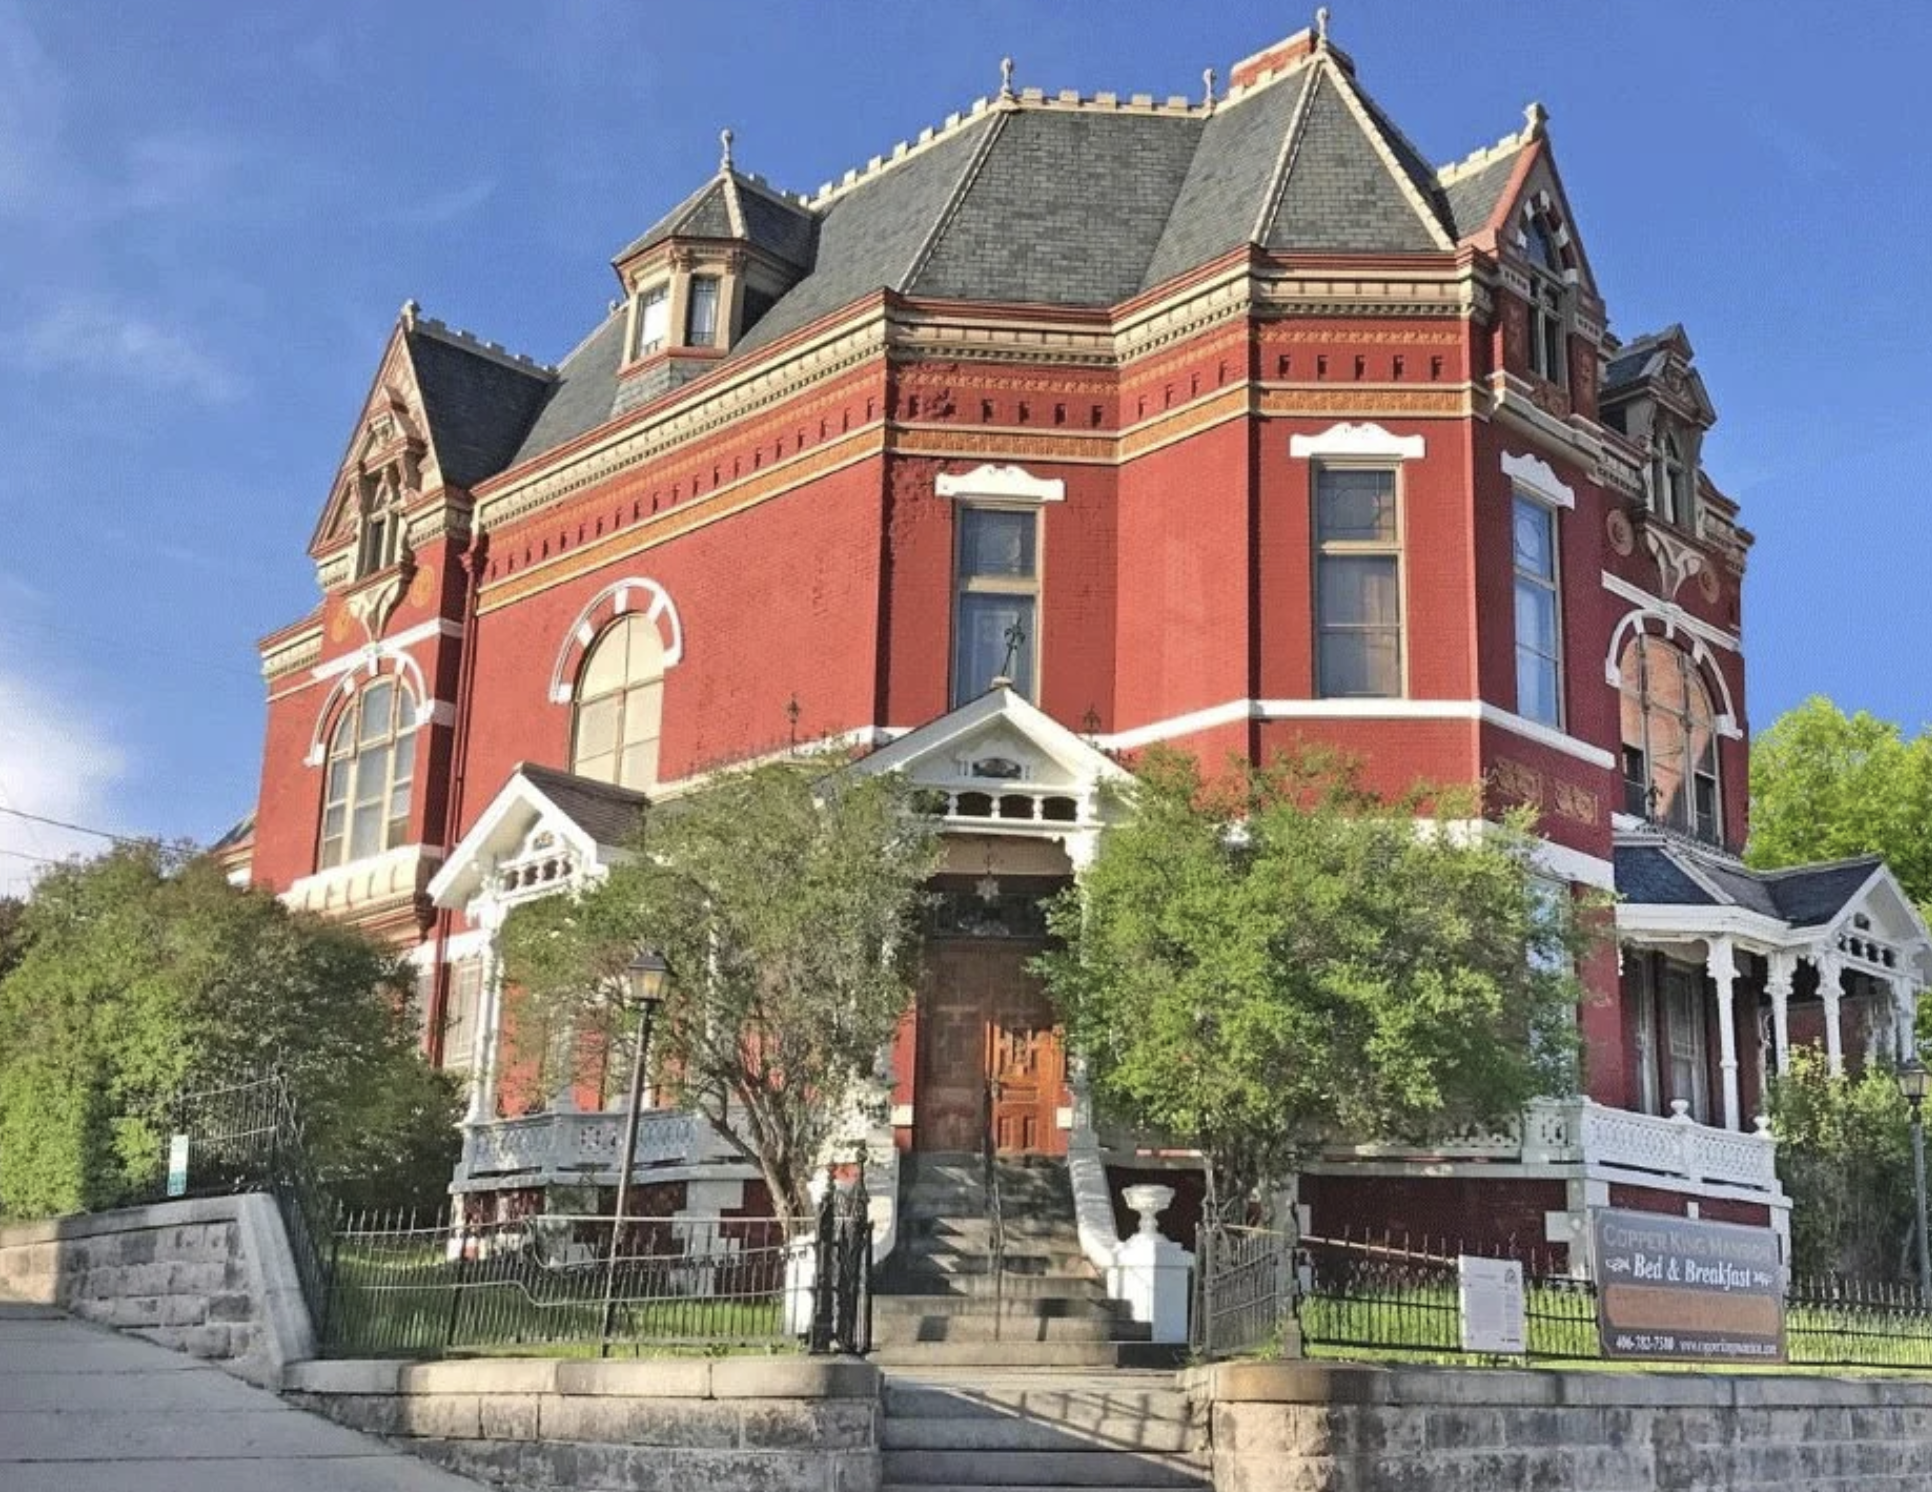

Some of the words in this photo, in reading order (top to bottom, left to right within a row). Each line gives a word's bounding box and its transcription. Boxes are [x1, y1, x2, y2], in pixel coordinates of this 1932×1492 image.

[1603, 1223, 1667, 1252] COPPER
[1669, 1231, 1706, 1255] KING
[1634, 1253, 1662, 1279] Bed
[1667, 1257, 1680, 1281] &
[1685, 1259, 1750, 1290] Breakfast
